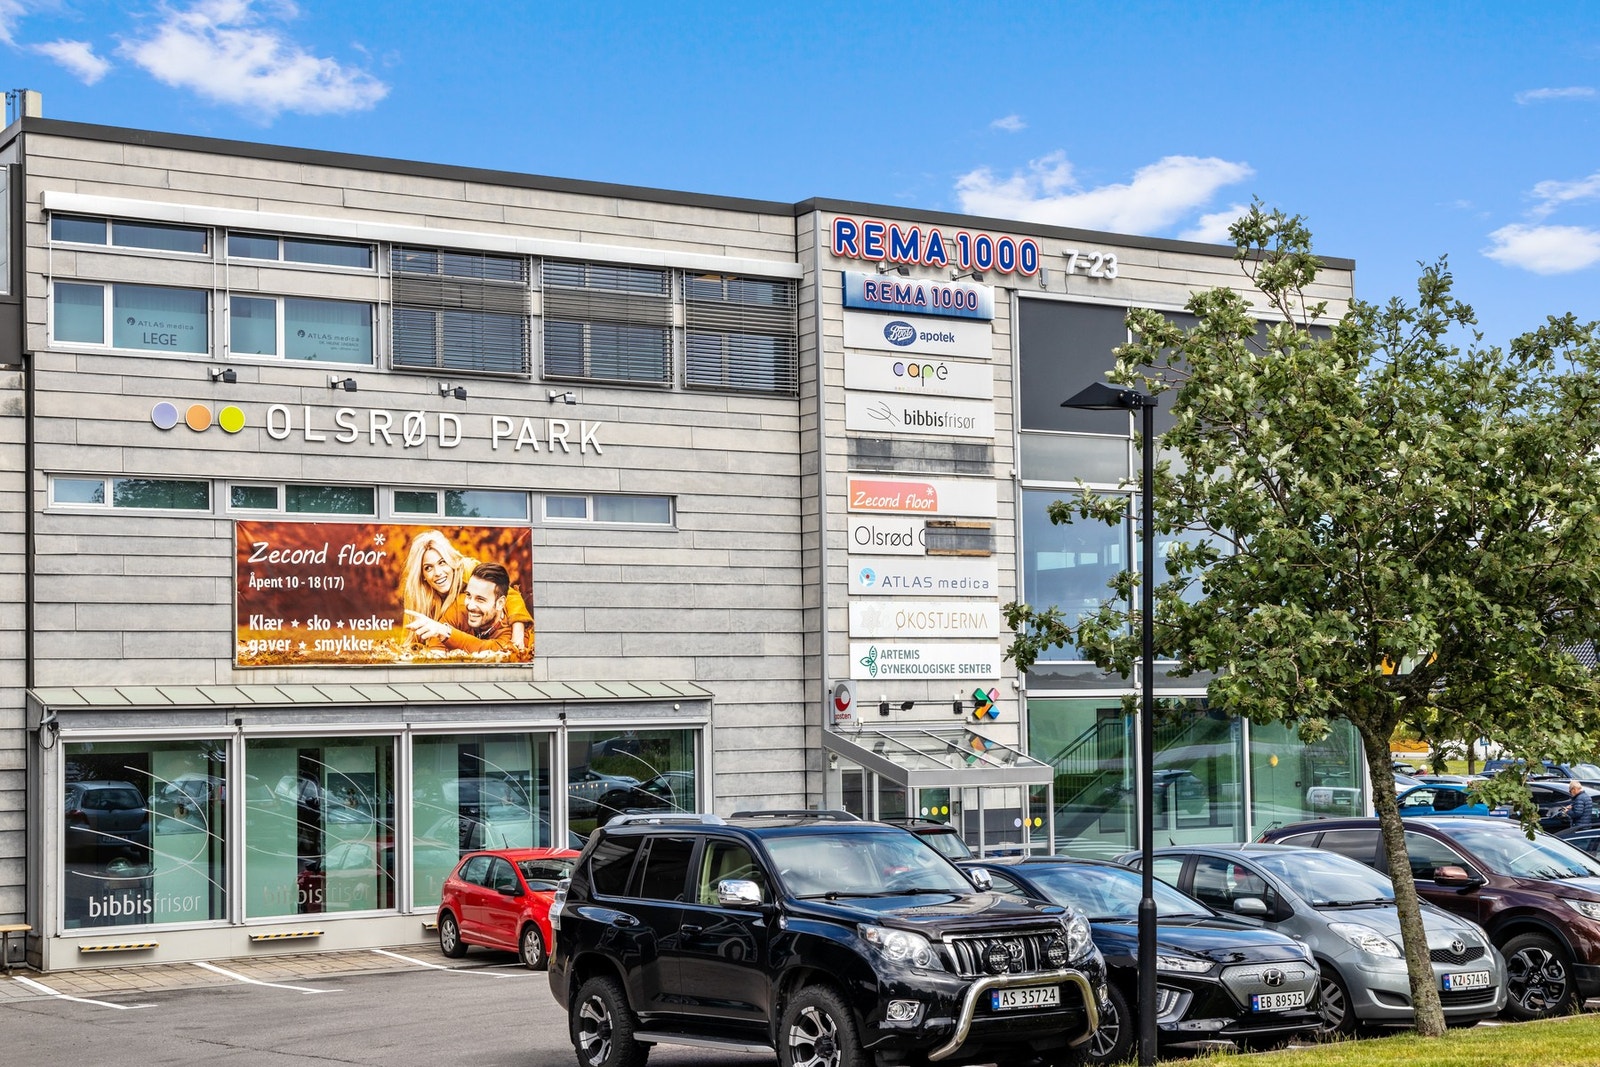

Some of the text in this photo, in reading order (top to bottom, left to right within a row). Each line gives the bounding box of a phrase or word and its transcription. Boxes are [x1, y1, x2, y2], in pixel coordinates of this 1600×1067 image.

[832, 217, 1040, 277] REMA 1000
[1063, 249, 1119, 279] 7-23
[864, 280, 979, 310] REMA 1000
[138, 320, 165, 328] ATLAS
[143, 332, 177, 346] LEGE
[920, 331, 955, 343] apotek
[893, 361, 948, 387] capé
[266, 403, 603, 454] OLSRØD PARK
[904, 408, 976, 429] bibbisfrisør
[853, 491, 900, 508] Zecond
[854, 525, 913, 547] Olsrød
[248, 542, 328, 565] Zecond
[248, 571, 283, 591] Åpent
[285, 576, 299, 588] 10
[882, 575, 989, 589] ATLAS medica
[249, 614, 395, 631] Klær sko vesker
[895, 609, 988, 631] ØKOSTJERNA
[249, 635, 373, 657] gaver smykker
[880, 649, 920, 660] ARTEMIS
[880, 663, 992, 674] GYNEKOLOGISKE SENTER
[89, 892, 201, 918] bibbisfrisør
[1452, 973, 1488, 986] KZ 57416
[1002, 988, 1056, 1006] AS 35724
[1260, 993, 1303, 1009] EB 89525
